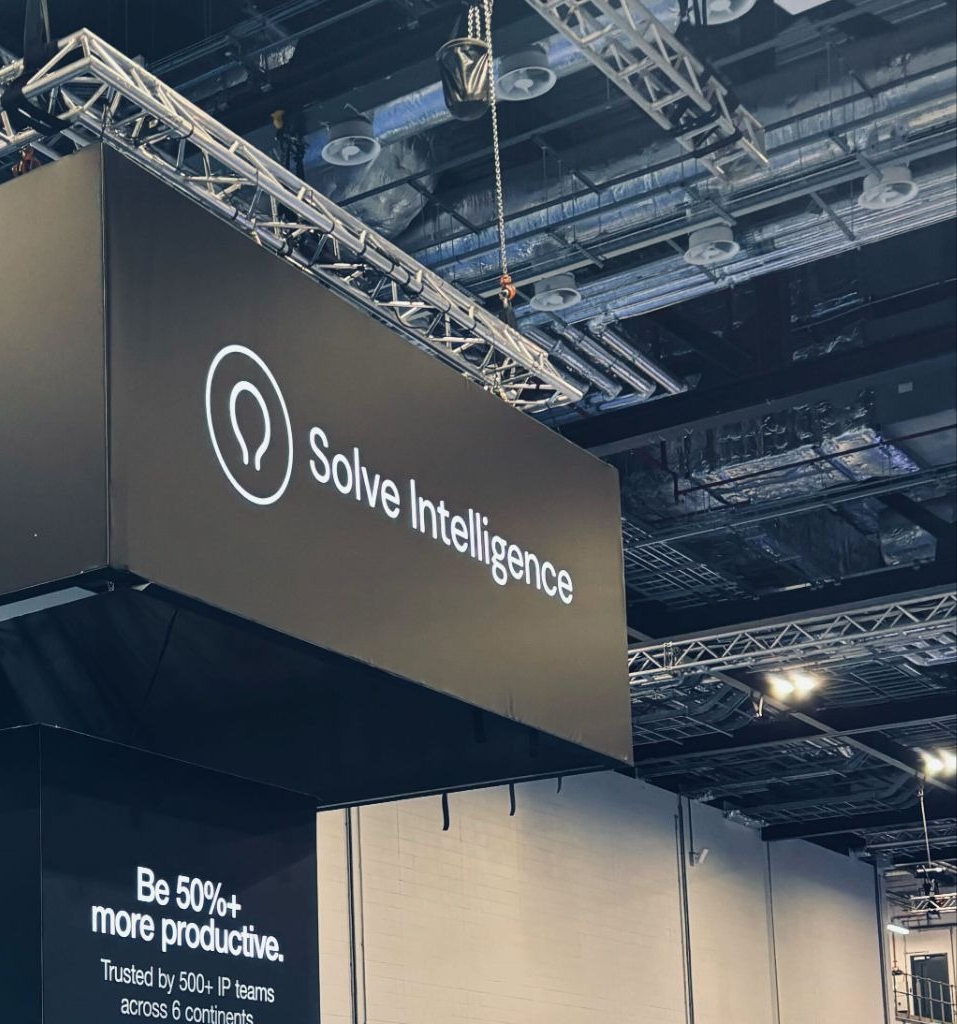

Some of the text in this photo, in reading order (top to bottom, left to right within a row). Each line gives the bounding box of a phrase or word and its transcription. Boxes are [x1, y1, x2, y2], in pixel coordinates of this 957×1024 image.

[309, 426, 573, 604] Solve Intelligence
[137, 866, 242, 919] Be 50%+
[91, 905, 284, 963] more productive.
[100, 958, 275, 1003] Trusted by 500+ IP teams
[121, 998, 168, 1019] across
[172, 1000, 181, 1020] 6
